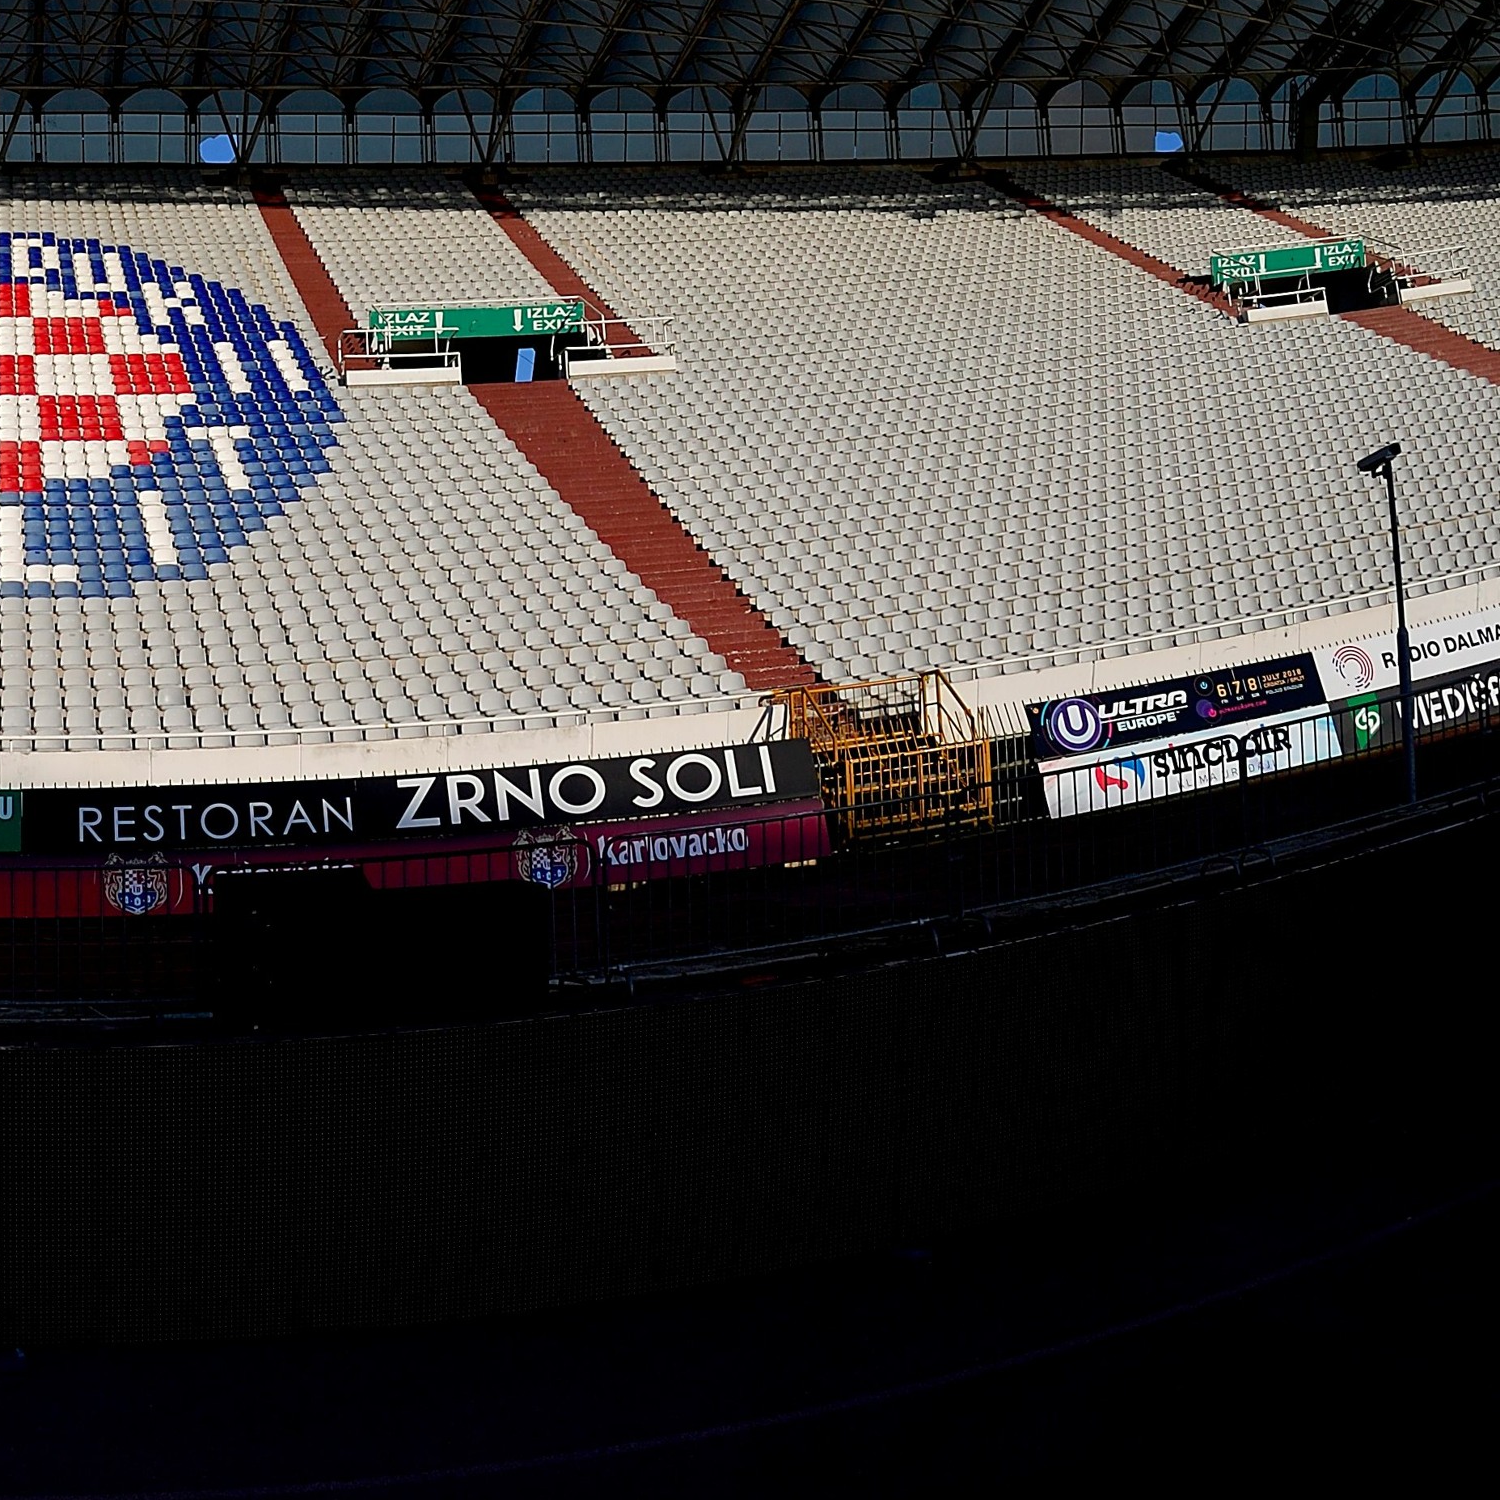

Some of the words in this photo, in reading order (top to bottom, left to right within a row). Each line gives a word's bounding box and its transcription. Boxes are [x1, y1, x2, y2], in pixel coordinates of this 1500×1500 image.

[1324, 243, 1359, 256] IZLAZ
[1218, 255, 1256, 268] IZLAZ
[378, 311, 430, 324] IZLAZ
[527, 305, 577, 319] IZLAZ
[384, 325, 424, 337] EXIT
[533, 318, 572, 331] EXIT
[1382, 641, 1440, 669] RDIO
[1261, 673, 1280, 683] JULY
[1283, 667, 1302, 678] 2018
[1098, 690, 1187, 719] ULTRA
[1116, 711, 1177, 732] EUROPE
[1177, 773, 1217, 787] KLMA
[78, 797, 354, 843] RESTORAN
[395, 765, 606, 829] ZRNO
[631, 745, 777, 808] SOLI
